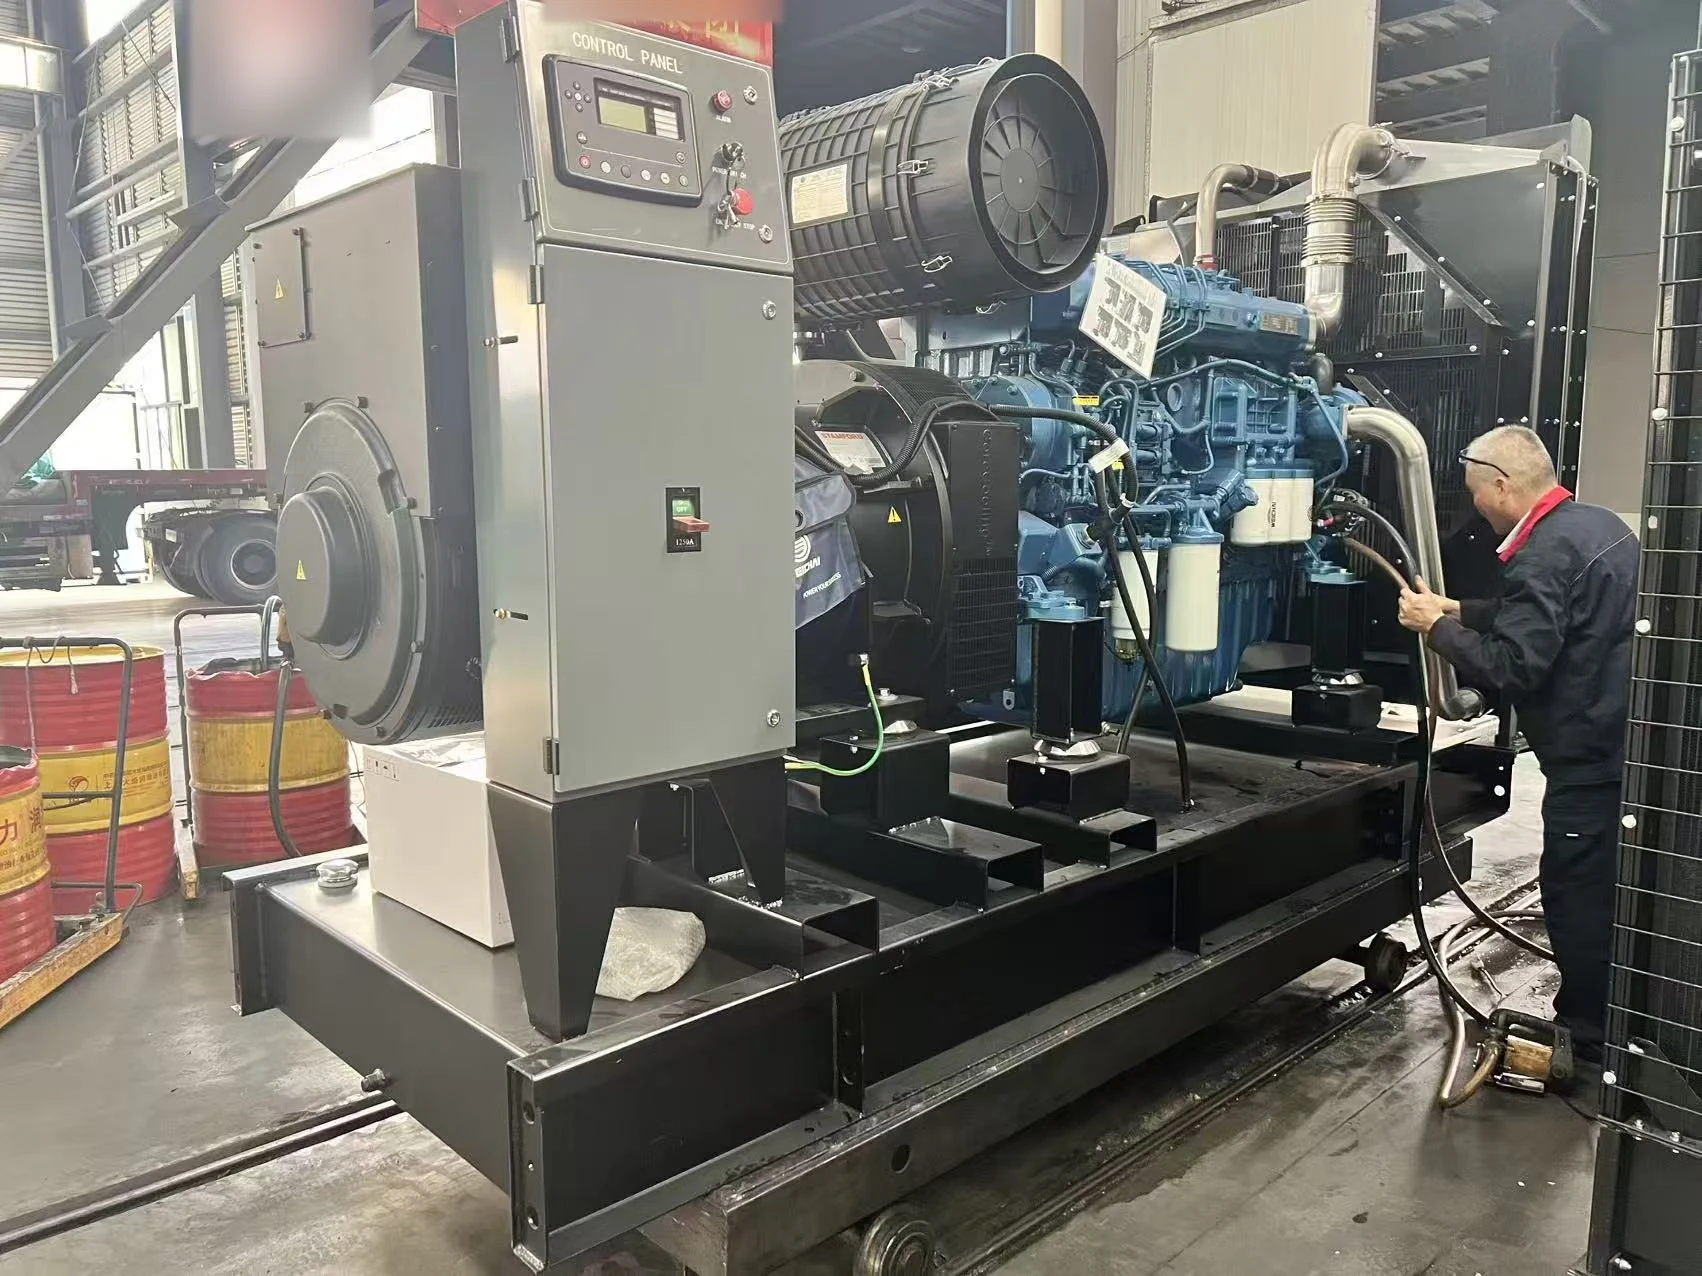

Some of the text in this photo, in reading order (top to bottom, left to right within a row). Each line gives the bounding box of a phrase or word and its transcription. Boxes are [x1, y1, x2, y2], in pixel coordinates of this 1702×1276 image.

[572, 32, 683, 74] CONTROL PANEL
[821, 432, 864, 440] STAMFORD
[676, 538, 694, 546] 1250A
